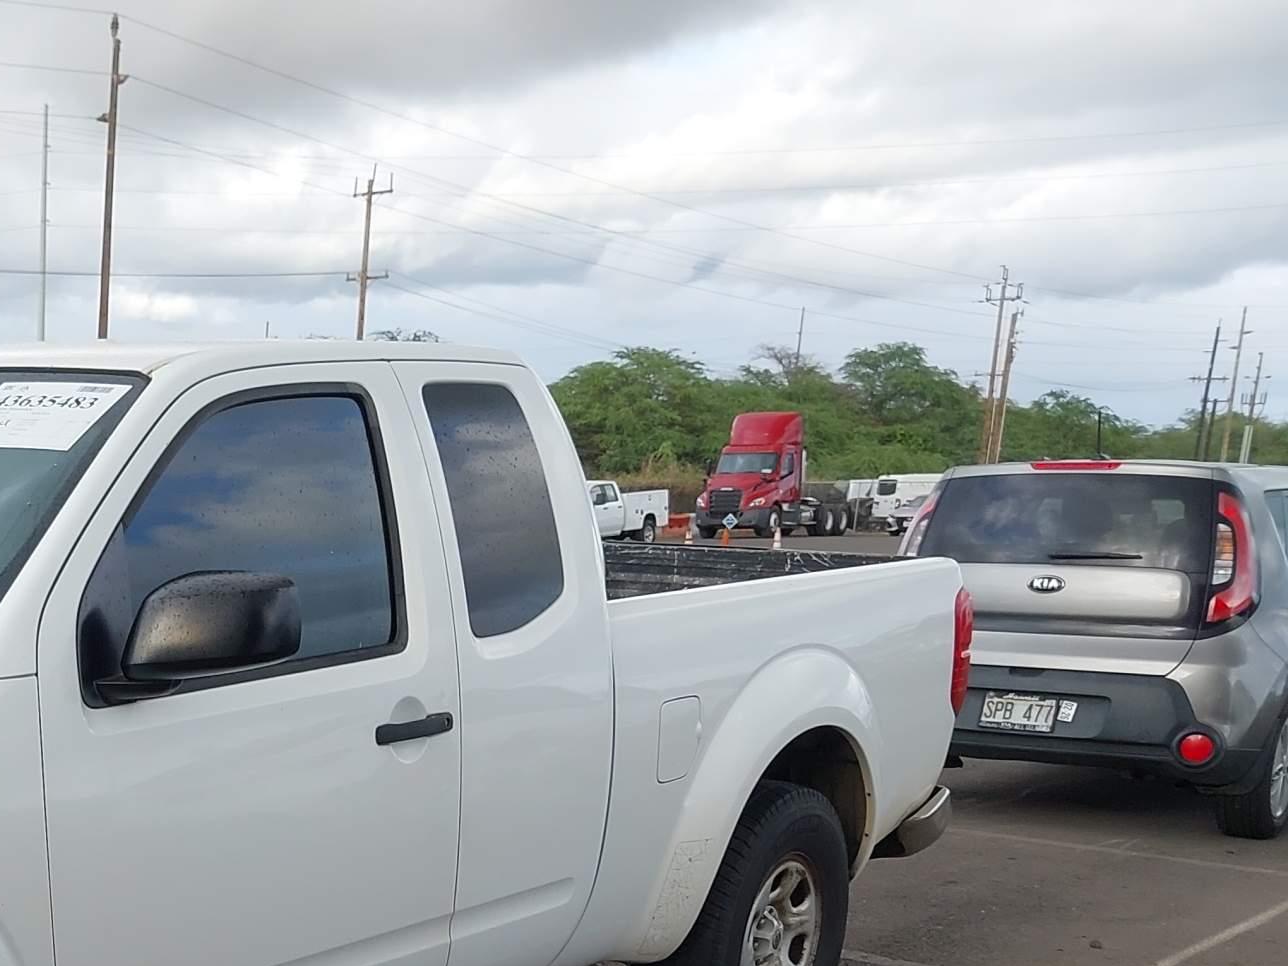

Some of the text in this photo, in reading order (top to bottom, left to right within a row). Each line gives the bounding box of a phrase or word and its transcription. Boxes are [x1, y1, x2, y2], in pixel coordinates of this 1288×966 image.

[1033, 578, 1059, 590] KIA
[984, 700, 1053, 724] SPB 477
